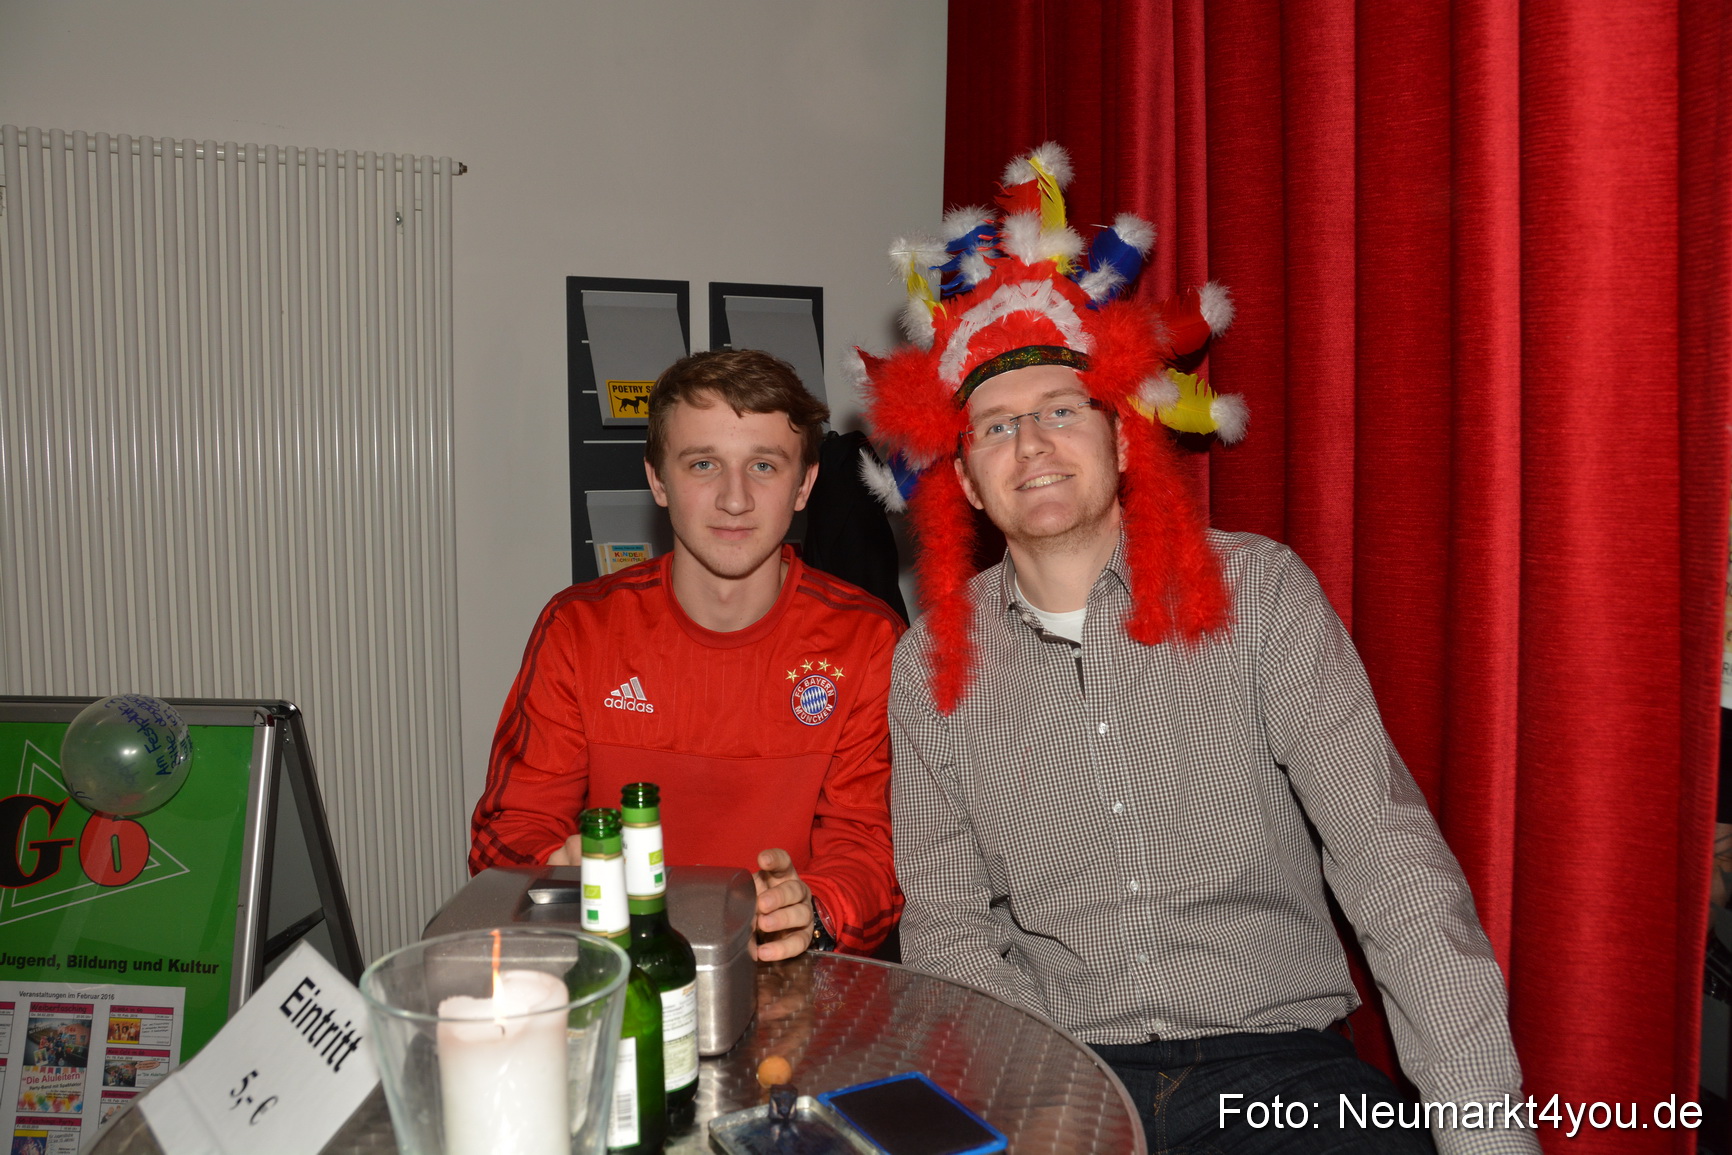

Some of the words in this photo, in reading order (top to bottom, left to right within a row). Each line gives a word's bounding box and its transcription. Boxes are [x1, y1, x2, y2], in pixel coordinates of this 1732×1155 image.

[612, 384, 643, 393] POETRY
[795, 686, 804, 698] FC
[804, 677, 835, 697] BAYERN
[603, 695, 655, 714] adidas
[0, 952, 60, 970] Jugend,
[67, 954, 128, 974] Bildung
[133, 958, 163, 972] und
[168, 958, 219, 974] Kultur
[19, 990, 67, 999] Veranstaltungen
[76, 992, 100, 1000] Februar
[279, 976, 363, 1073] Eintritt
